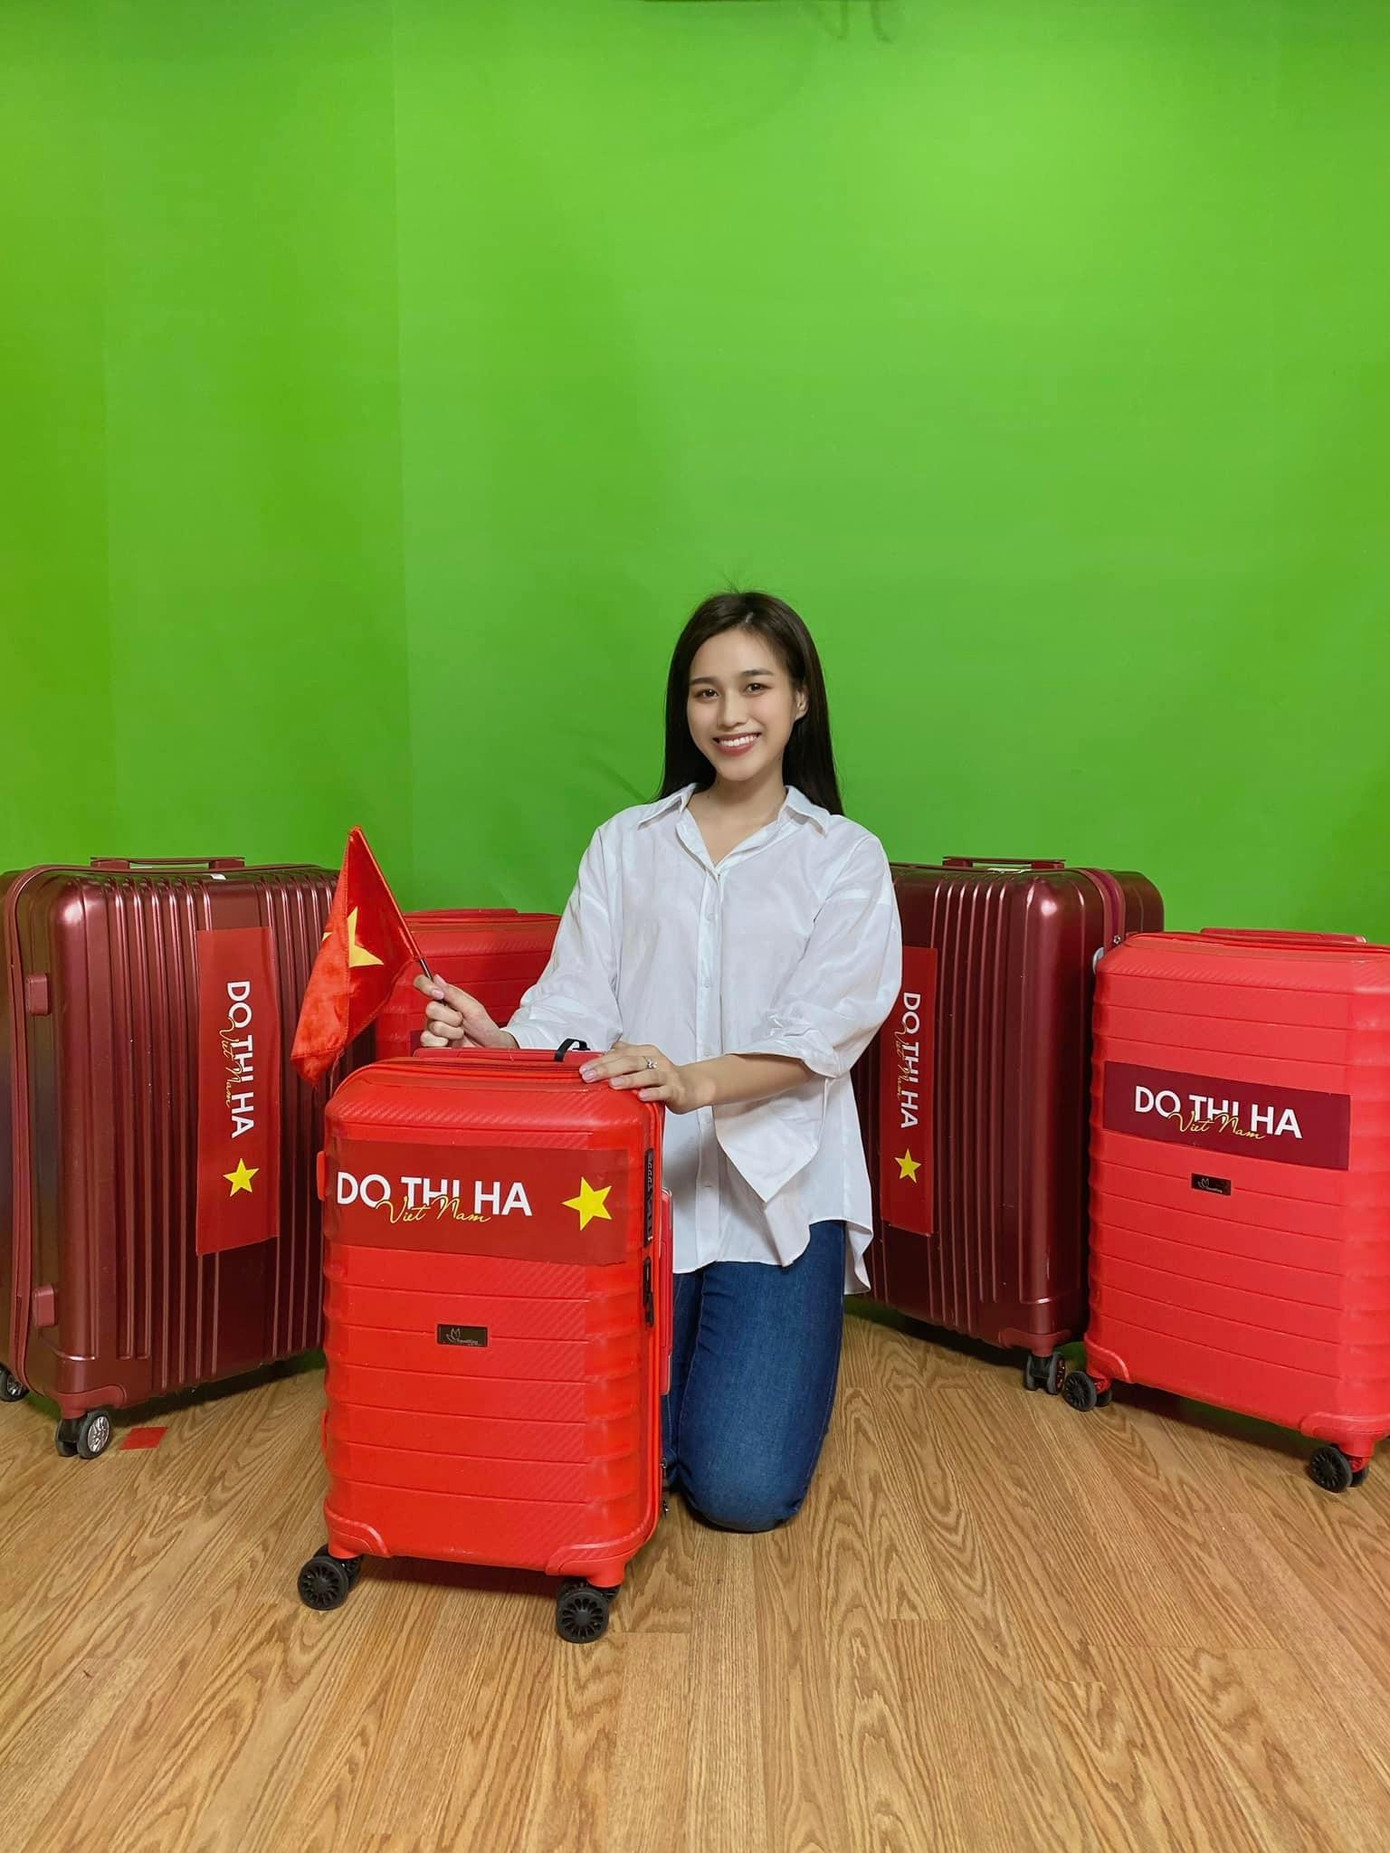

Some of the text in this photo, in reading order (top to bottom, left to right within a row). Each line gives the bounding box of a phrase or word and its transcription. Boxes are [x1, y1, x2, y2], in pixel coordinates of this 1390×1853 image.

[227, 981, 254, 1139] DO THI HA
[901, 992, 921, 1128] DO THI HA
[1135, 1086, 1303, 1139] DO THI HA
[1168, 1110, 1266, 1140] Viet Nam
[337, 1172, 532, 1216] DO THI HA
[376, 1195, 491, 1223] Viet Nam
